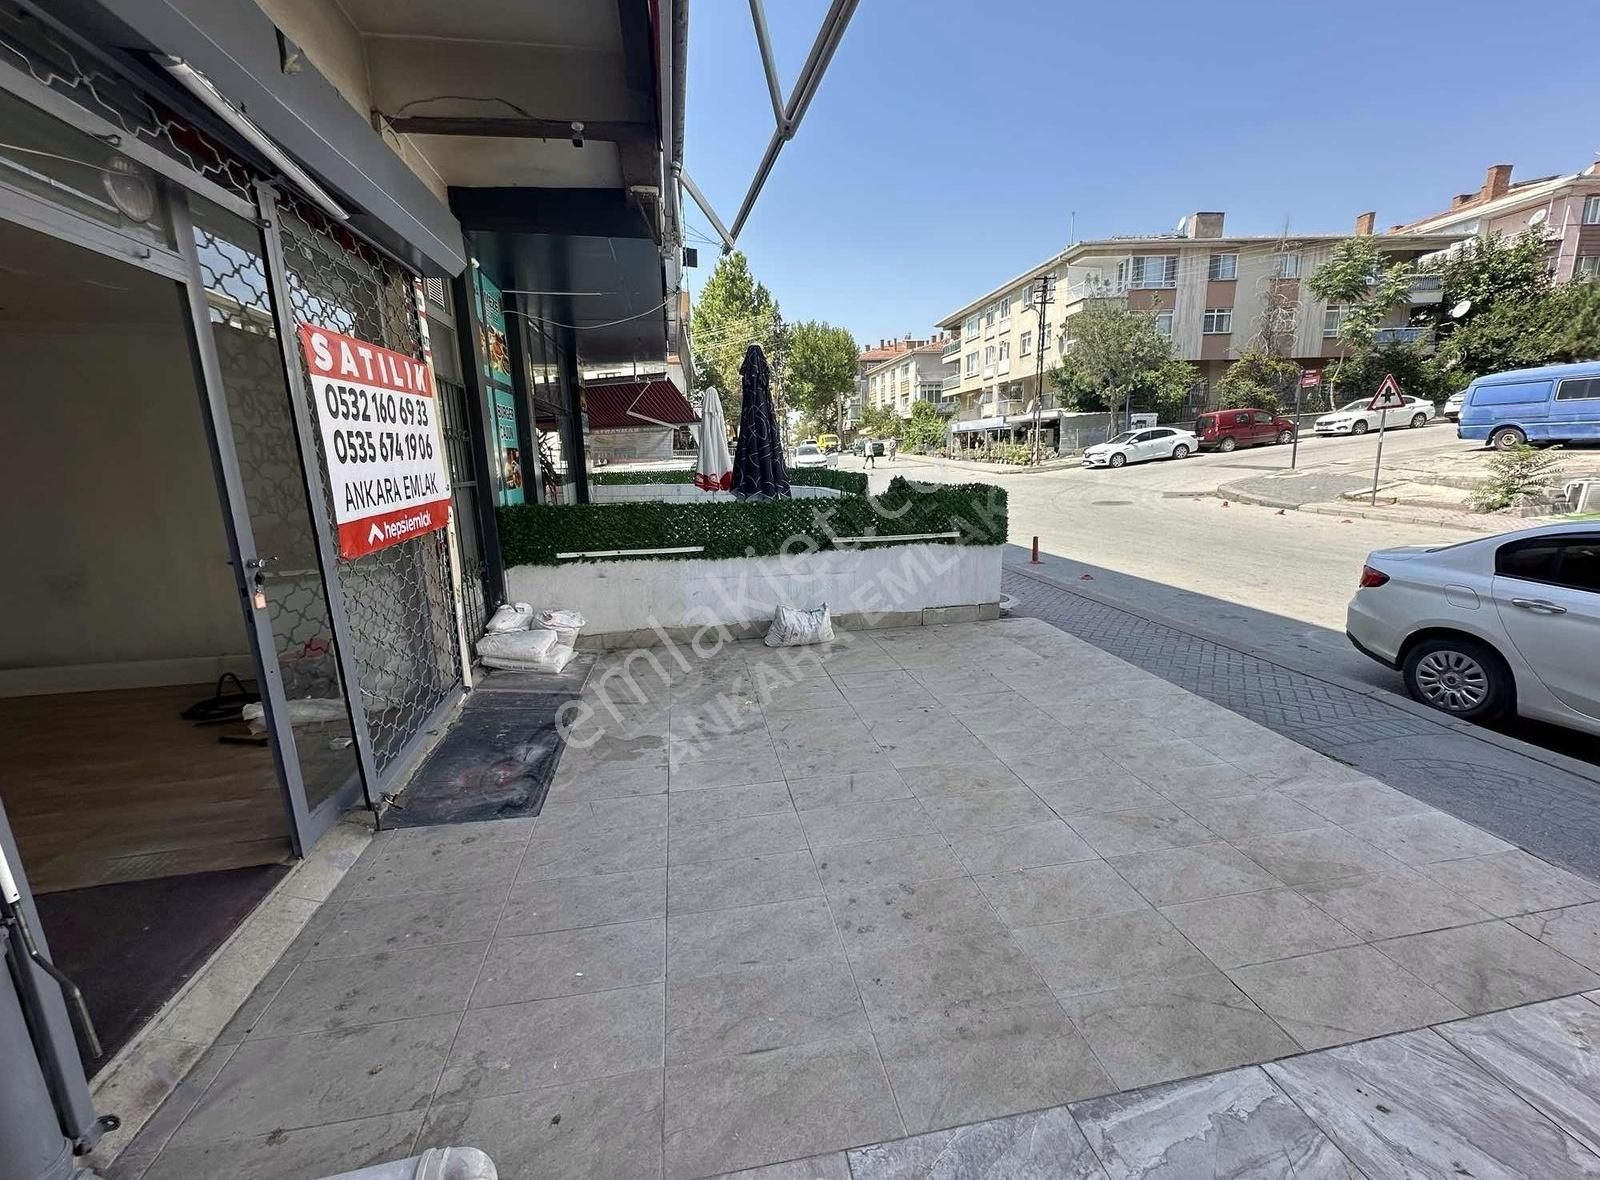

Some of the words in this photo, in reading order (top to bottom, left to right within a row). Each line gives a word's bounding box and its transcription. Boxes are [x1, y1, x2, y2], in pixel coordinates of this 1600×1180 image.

[311, 332, 426, 393] SATILIK
[325, 384, 371, 422] 0532
[371, 392, 396, 424] 160
[400, 397, 414, 425] 69
[416, 399, 428, 426] 33
[333, 429, 376, 464] 0535
[379, 432, 404, 463] 674
[405, 433, 417, 461] 19
[418, 433, 433, 460] 06
[345, 477, 402, 512] ANKARA
[403, 472, 439, 500] EMLAK
[384, 510, 432, 539] hepsiemlak
